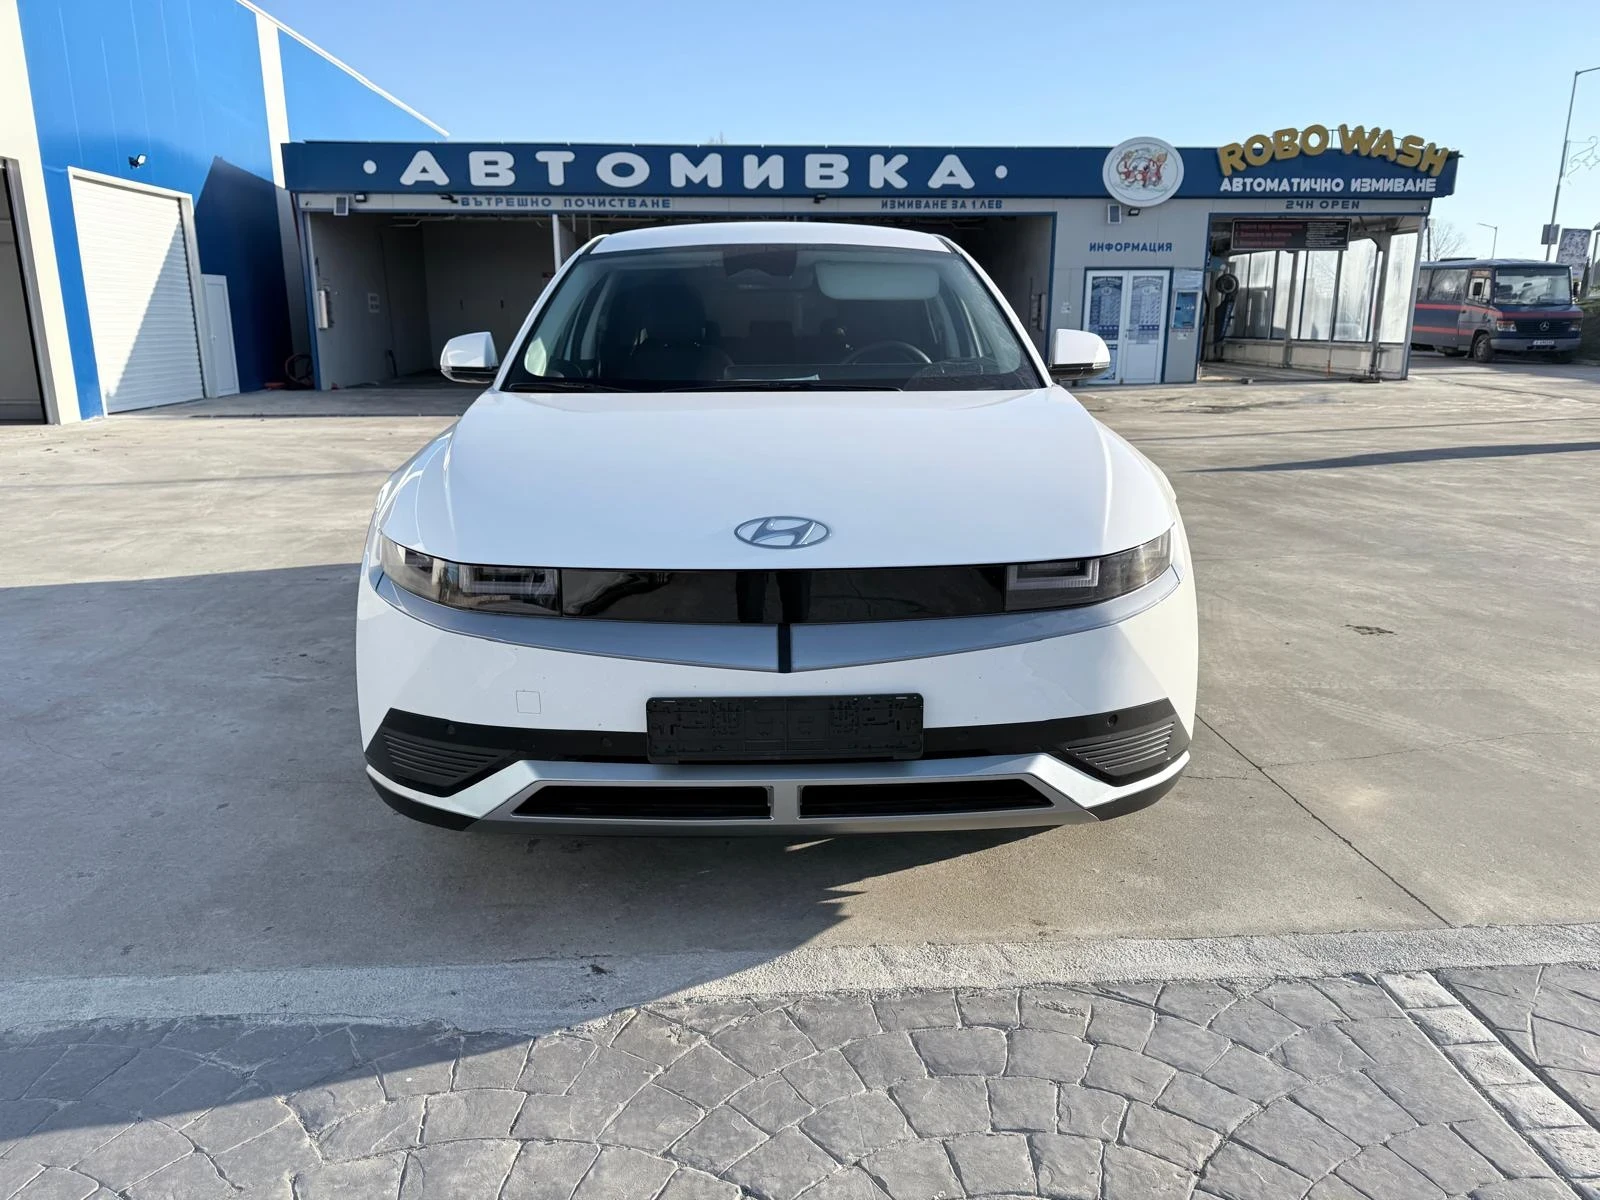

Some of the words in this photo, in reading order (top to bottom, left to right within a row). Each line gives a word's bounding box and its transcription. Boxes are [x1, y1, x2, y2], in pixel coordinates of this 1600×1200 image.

[1219, 124, 1330, 176] ROBO
[1338, 124, 1450, 176] WASH
[400, 150, 975, 189] АВТОМИВКА
[1220, 177, 1344, 193] АВТОМАТИЧНО
[1351, 177, 1436, 193] ИЗМИВАНЕ
[461, 196, 552, 208] ВЪТРЕШНО
[563, 197, 671, 209] ПОЧИСТВАНЕ
[881, 199, 948, 209] ИЗМИВАНЕ
[951, 200, 968, 209] ЗА
[979, 200, 1003, 209] ЛЕВ
[1319, 200, 1360, 210] OPEN
[1089, 242, 1172, 252] ИНФОРМАЦИЯ
